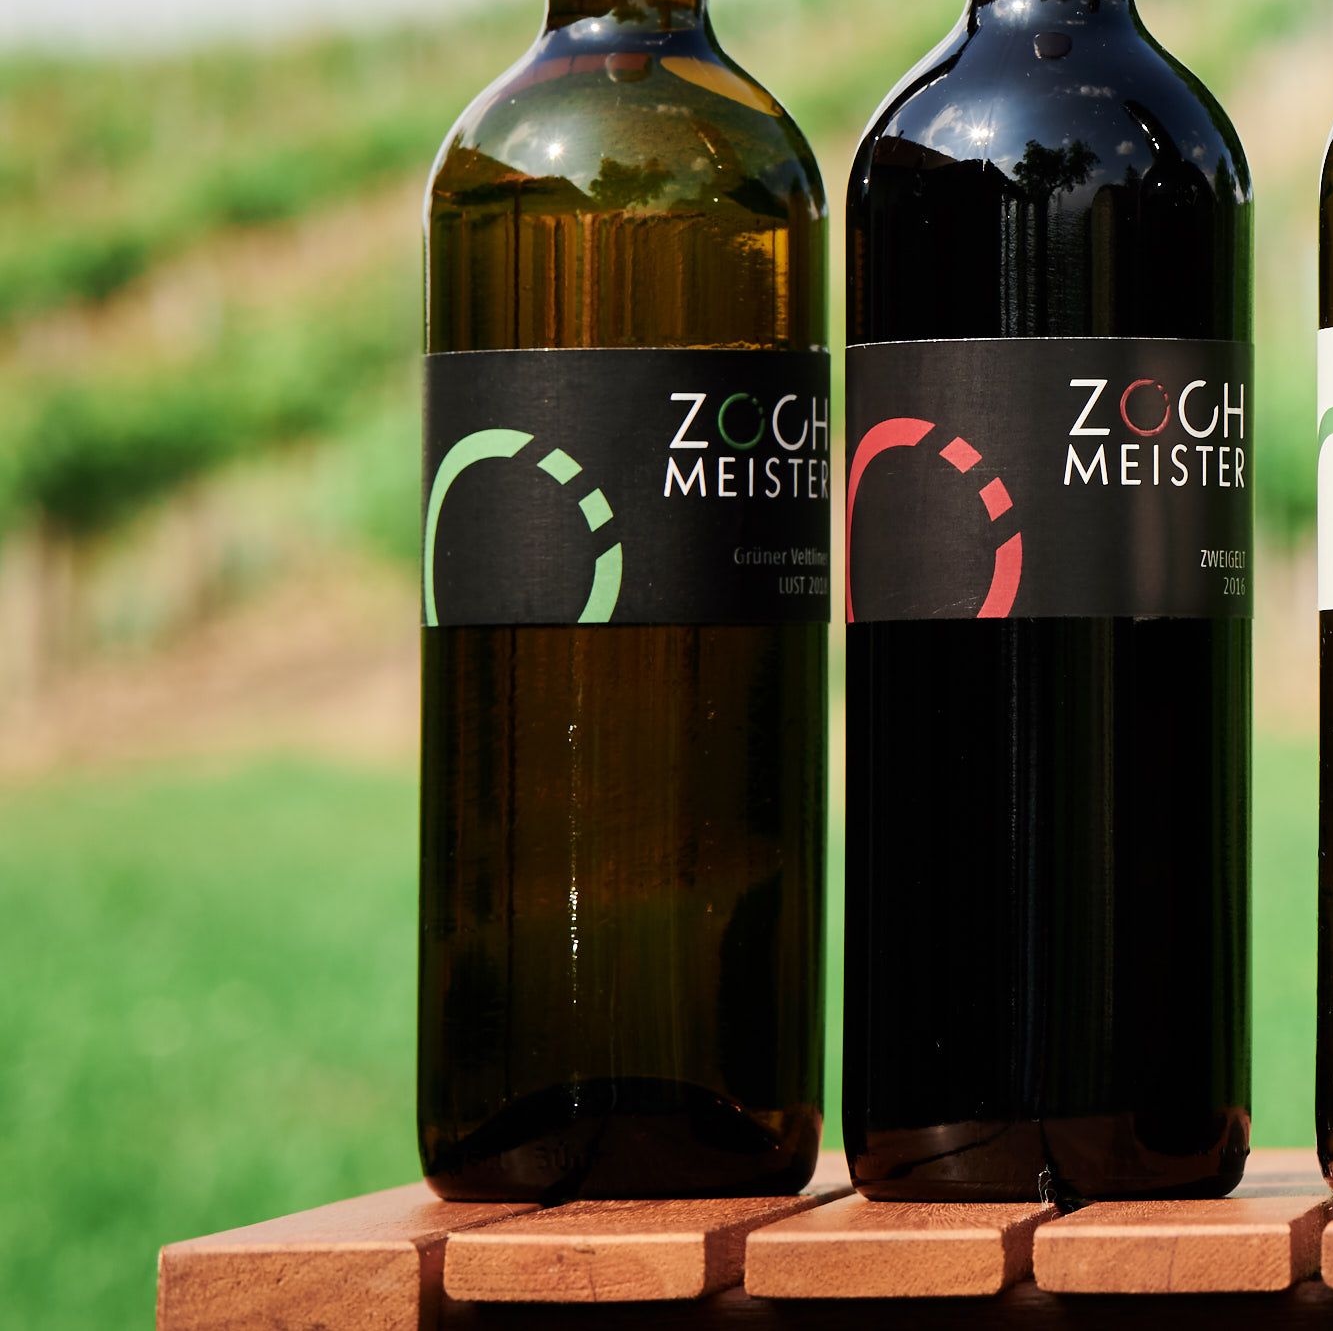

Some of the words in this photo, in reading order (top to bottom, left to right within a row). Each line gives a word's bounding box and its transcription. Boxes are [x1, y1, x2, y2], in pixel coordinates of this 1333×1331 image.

[1063, 443, 1246, 489] MEISTER
[663, 456, 829, 499] MEISTER
[733, 546, 787, 565] Grüner
[1200, 549, 1246, 569] ZWEIGELT
[779, 576, 806, 595] LUST
[1223, 576, 1246, 595] 2016
